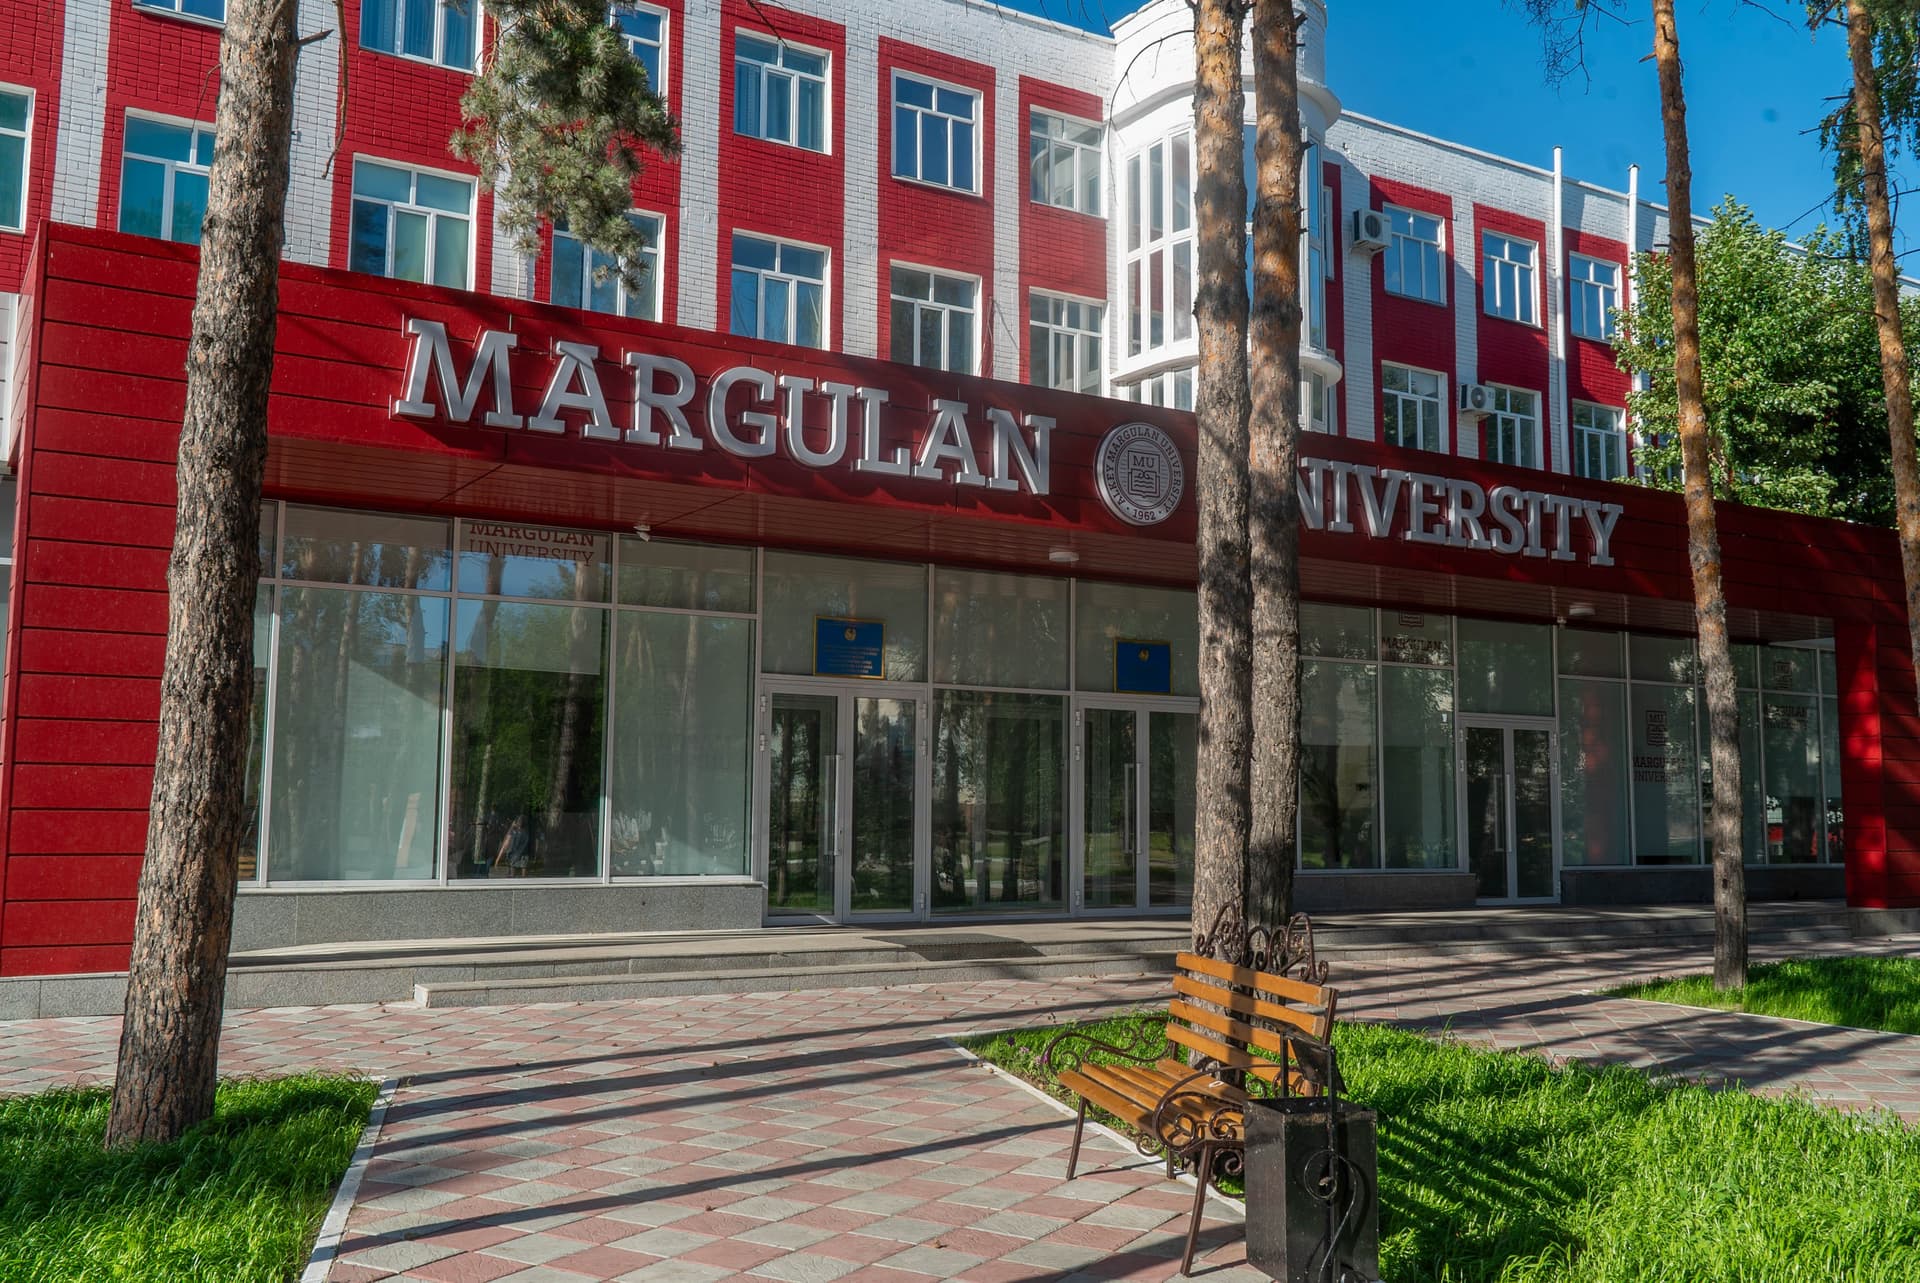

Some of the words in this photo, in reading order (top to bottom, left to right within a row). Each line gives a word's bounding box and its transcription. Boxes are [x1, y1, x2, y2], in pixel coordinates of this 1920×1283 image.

[395, 318, 1057, 495] MARGULAN
[1296, 456, 1624, 567] NIVERSITY
[1108, 427, 1160, 462] MARGULAN
[1133, 455, 1155, 468] MU
[1161, 437, 1181, 513] UNIVERSITY
[1106, 465, 1125, 505] ALKEY
[1132, 509, 1157, 520] 1962
[469, 523, 595, 547] MARGULAN
[469, 539, 595, 567] UNIVERSITY
